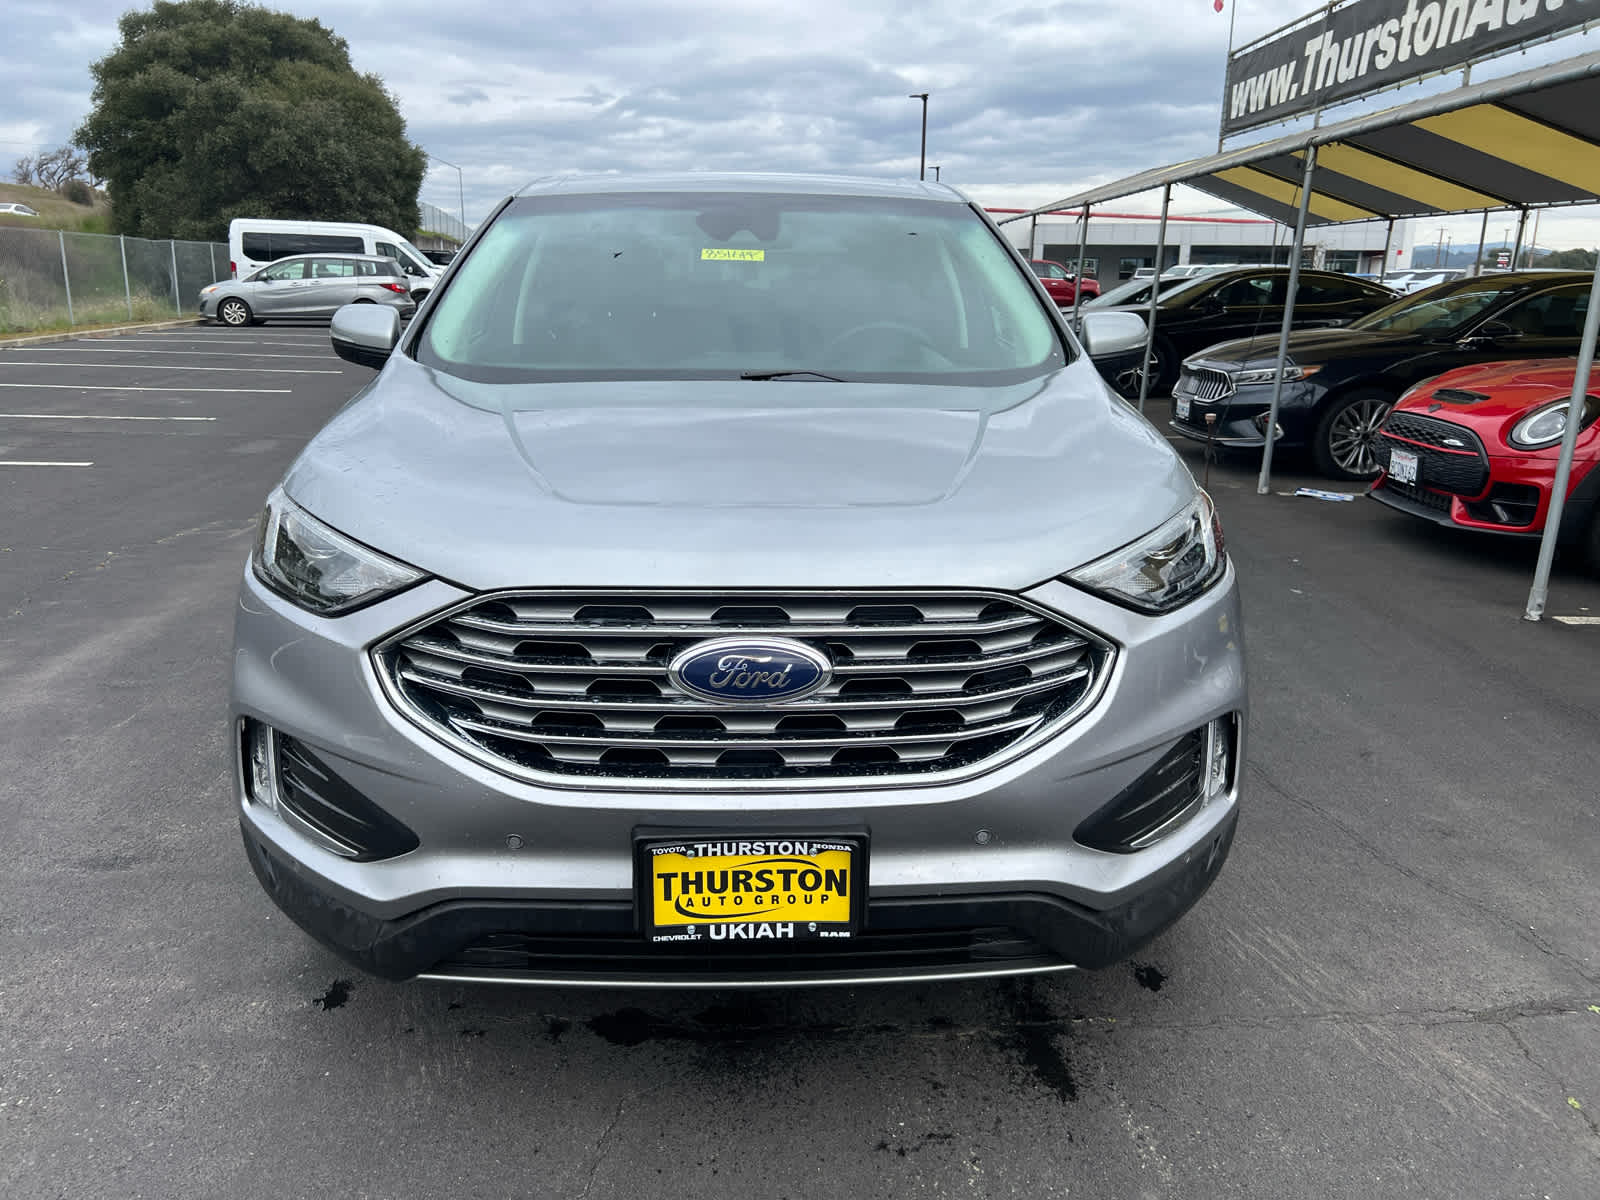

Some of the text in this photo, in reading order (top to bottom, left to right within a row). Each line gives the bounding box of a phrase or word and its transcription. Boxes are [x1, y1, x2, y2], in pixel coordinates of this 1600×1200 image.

[709, 654, 793, 689] Ford
[652, 846, 687, 855] TOYOTA
[694, 841, 808, 857] THURSTON
[812, 843, 852, 852] HONDA
[657, 869, 847, 901] THURSTON
[686, 894, 830, 908] AUTO GROUP
[653, 934, 702, 942] CHEVROLET
[709, 922, 794, 940] UKIAH
